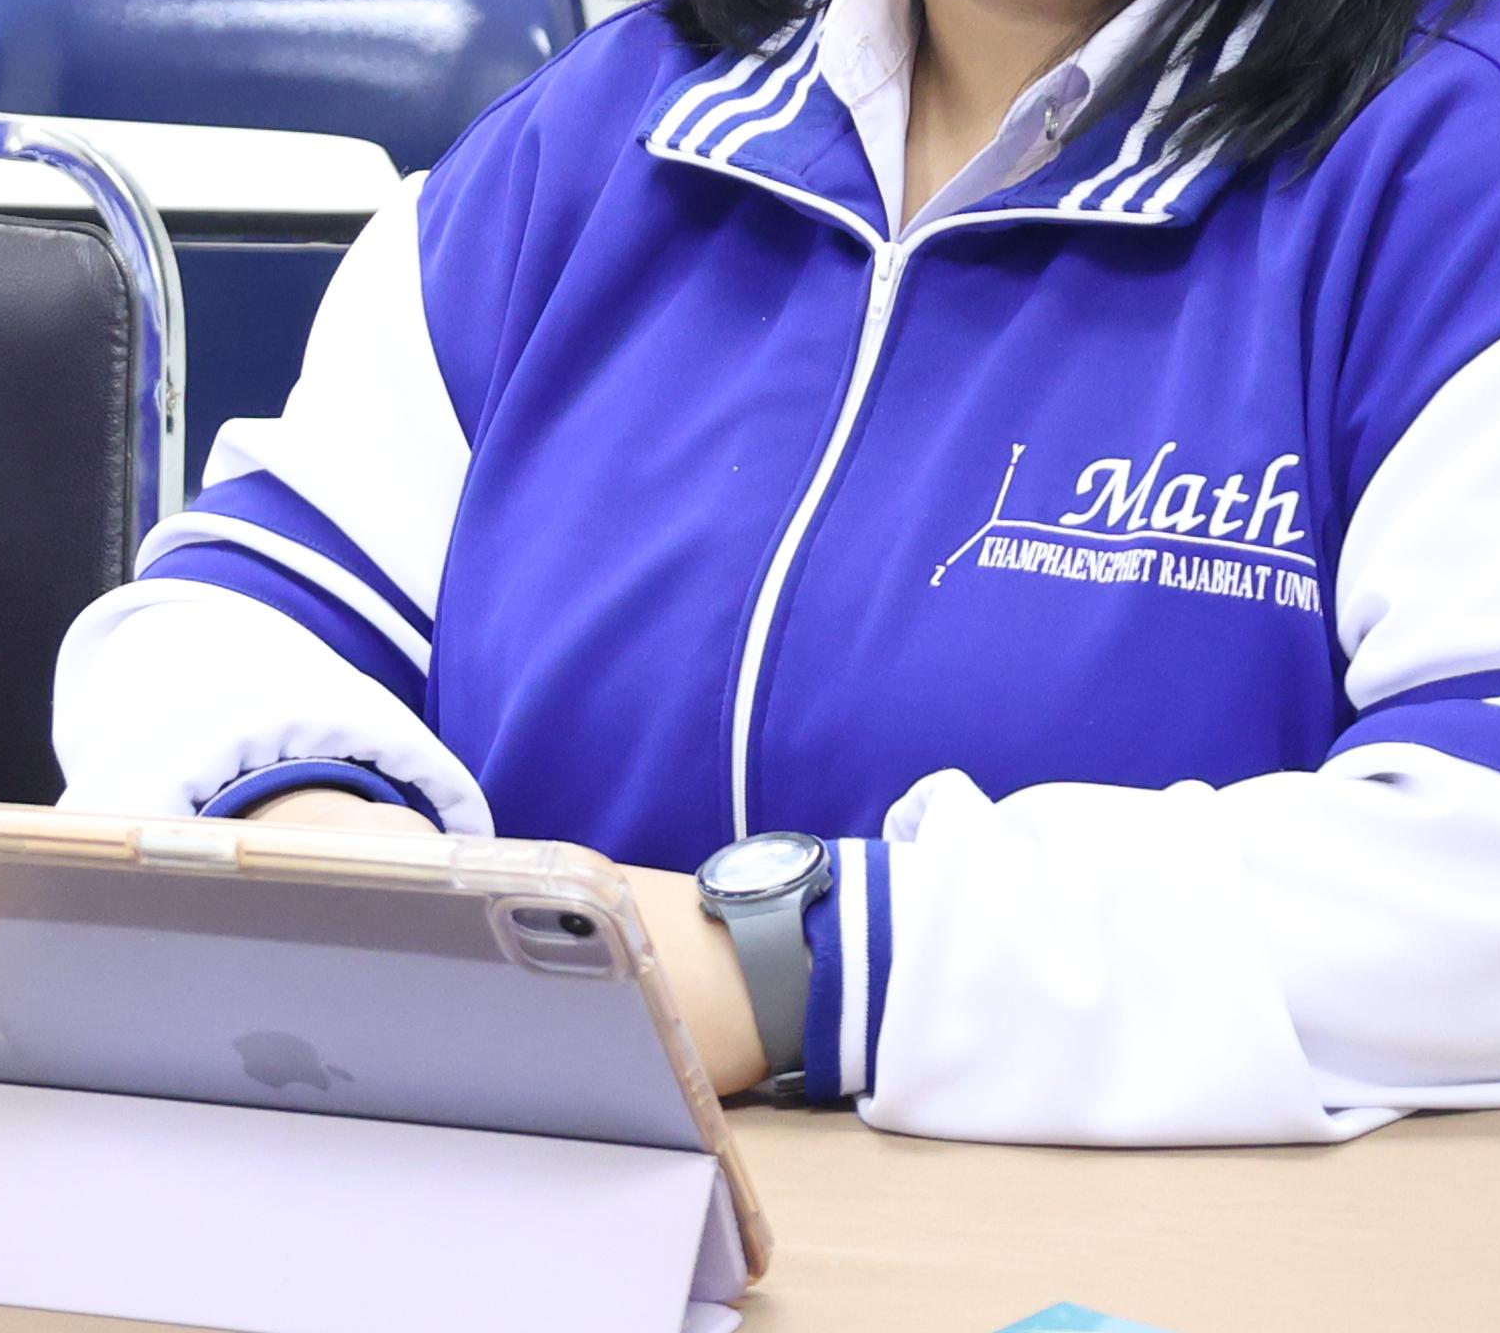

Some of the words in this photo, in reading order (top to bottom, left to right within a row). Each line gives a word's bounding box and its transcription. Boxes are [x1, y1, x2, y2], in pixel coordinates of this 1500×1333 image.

[1059, 441, 1305, 546] Math
[977, 536, 1157, 583] KHAMPHAENGPHET
[1158, 549, 1272, 601] RAJABHAT
[1275, 569, 1323, 616] UNIV
